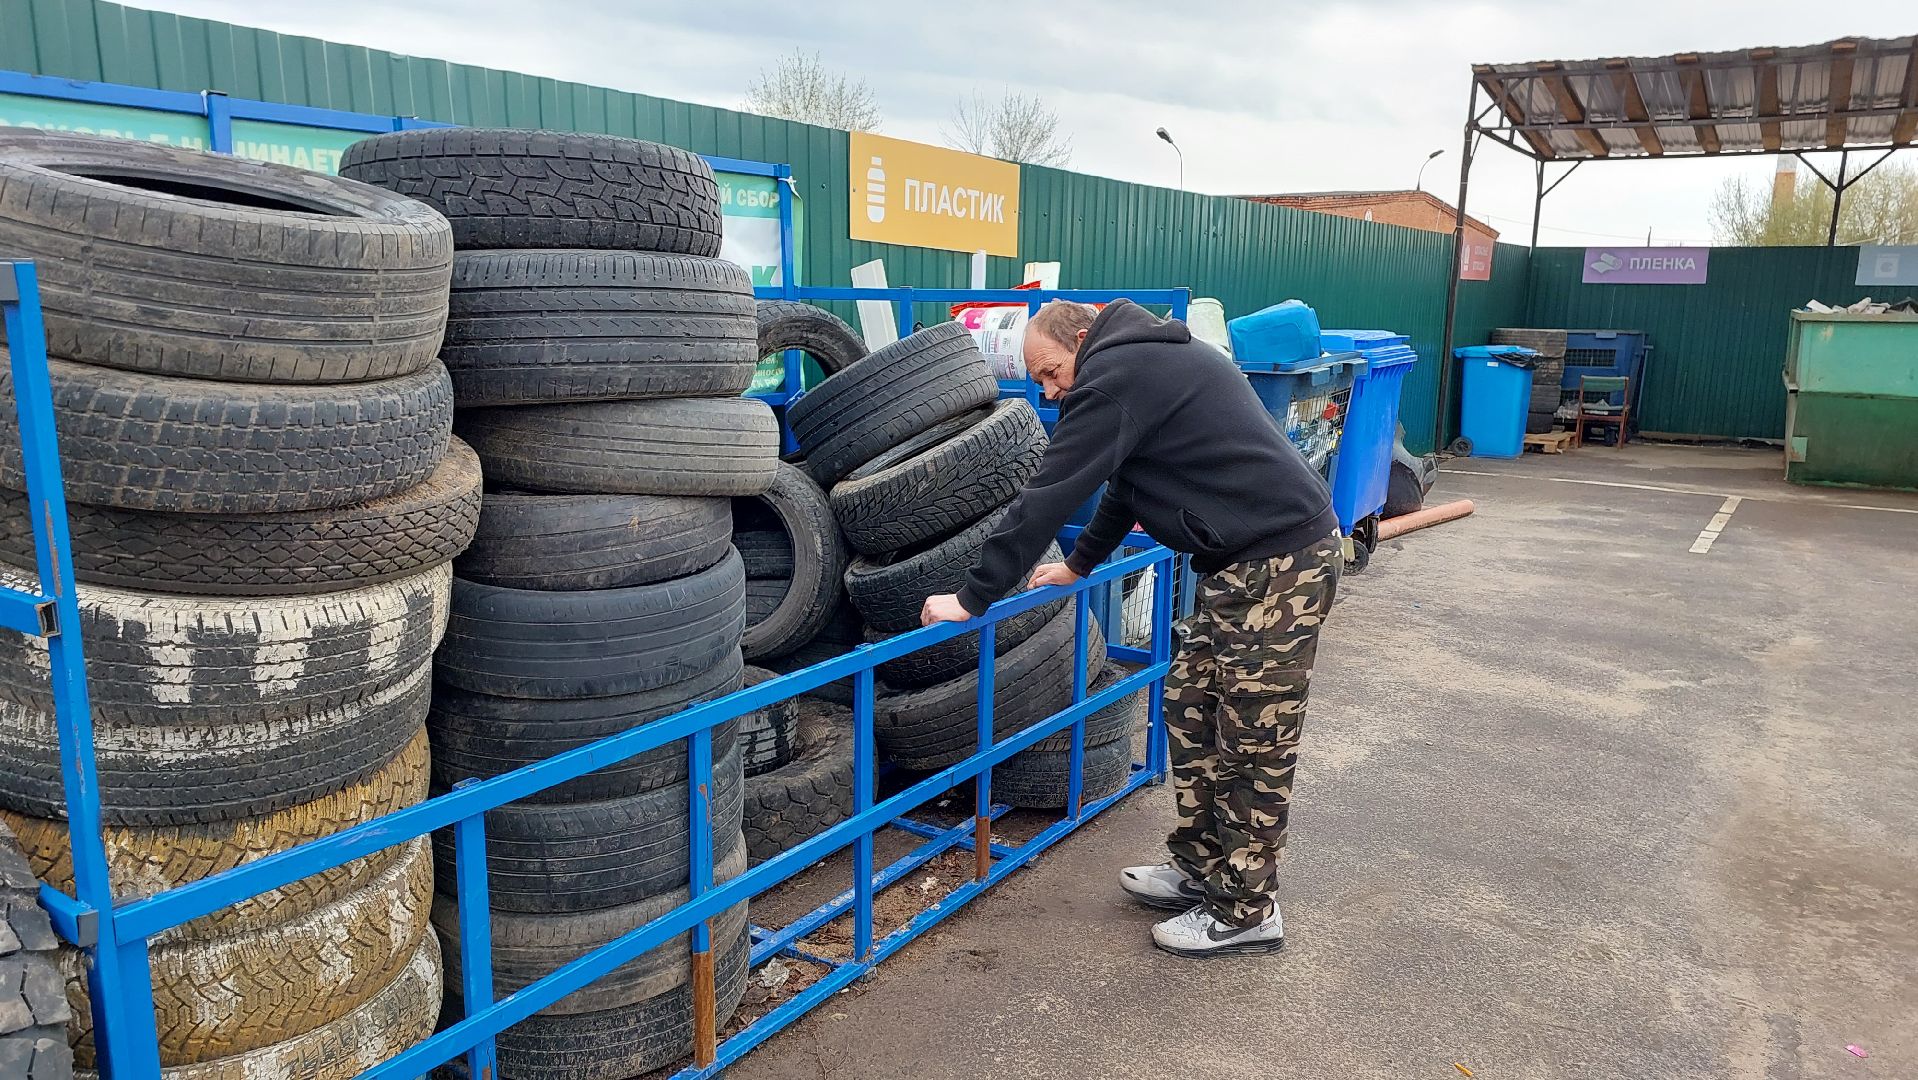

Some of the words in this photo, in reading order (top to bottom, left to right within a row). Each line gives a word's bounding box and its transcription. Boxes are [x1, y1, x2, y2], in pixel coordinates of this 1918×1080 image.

[737, 188, 780, 208] СБОР
[904, 178, 1005, 224] ПЛАСТИК
[1629, 257, 1696, 270] ПЛЕНКА
